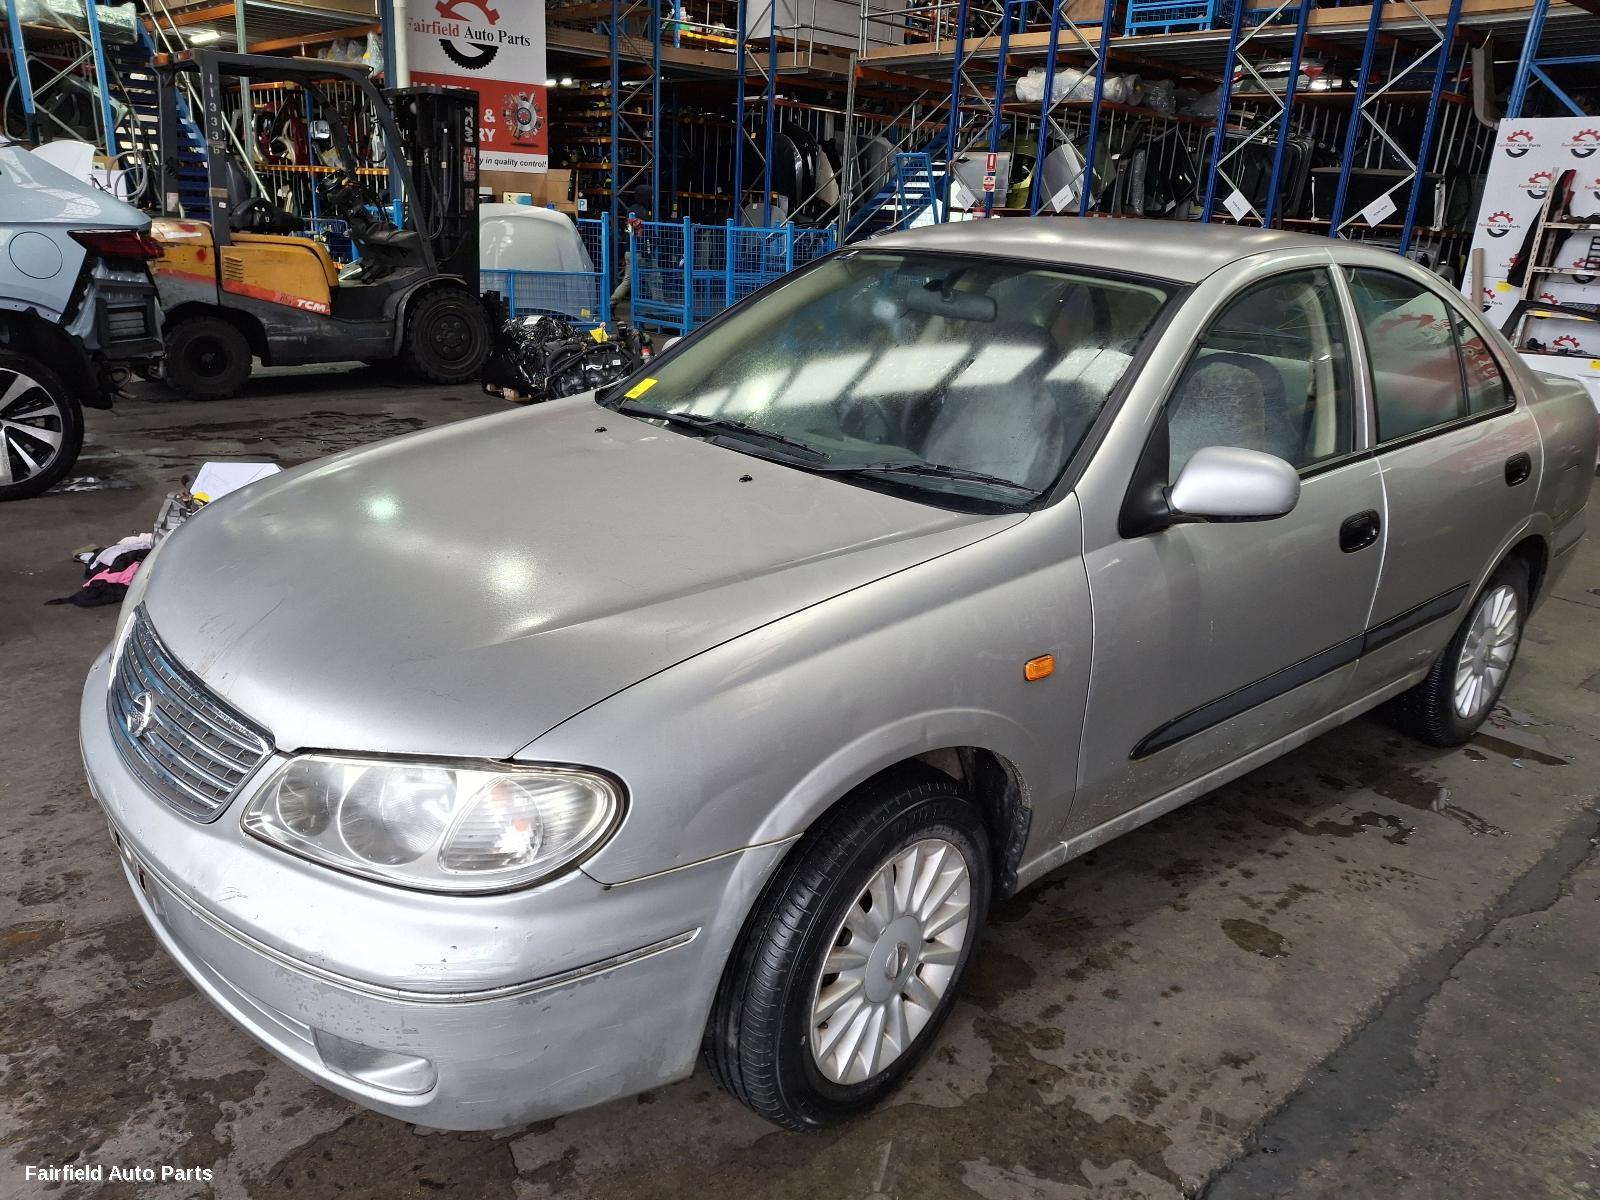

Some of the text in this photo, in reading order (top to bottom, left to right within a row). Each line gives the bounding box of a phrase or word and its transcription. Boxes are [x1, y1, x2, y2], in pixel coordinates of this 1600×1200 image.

[463, 26, 494, 42] Auto
[498, 30, 531, 47] Parts
[484, 108, 496, 123] &
[464, 106, 474, 143] TCM
[485, 156, 493, 165] in
[494, 158, 519, 168] quality
[297, 299, 326, 312] TCM
